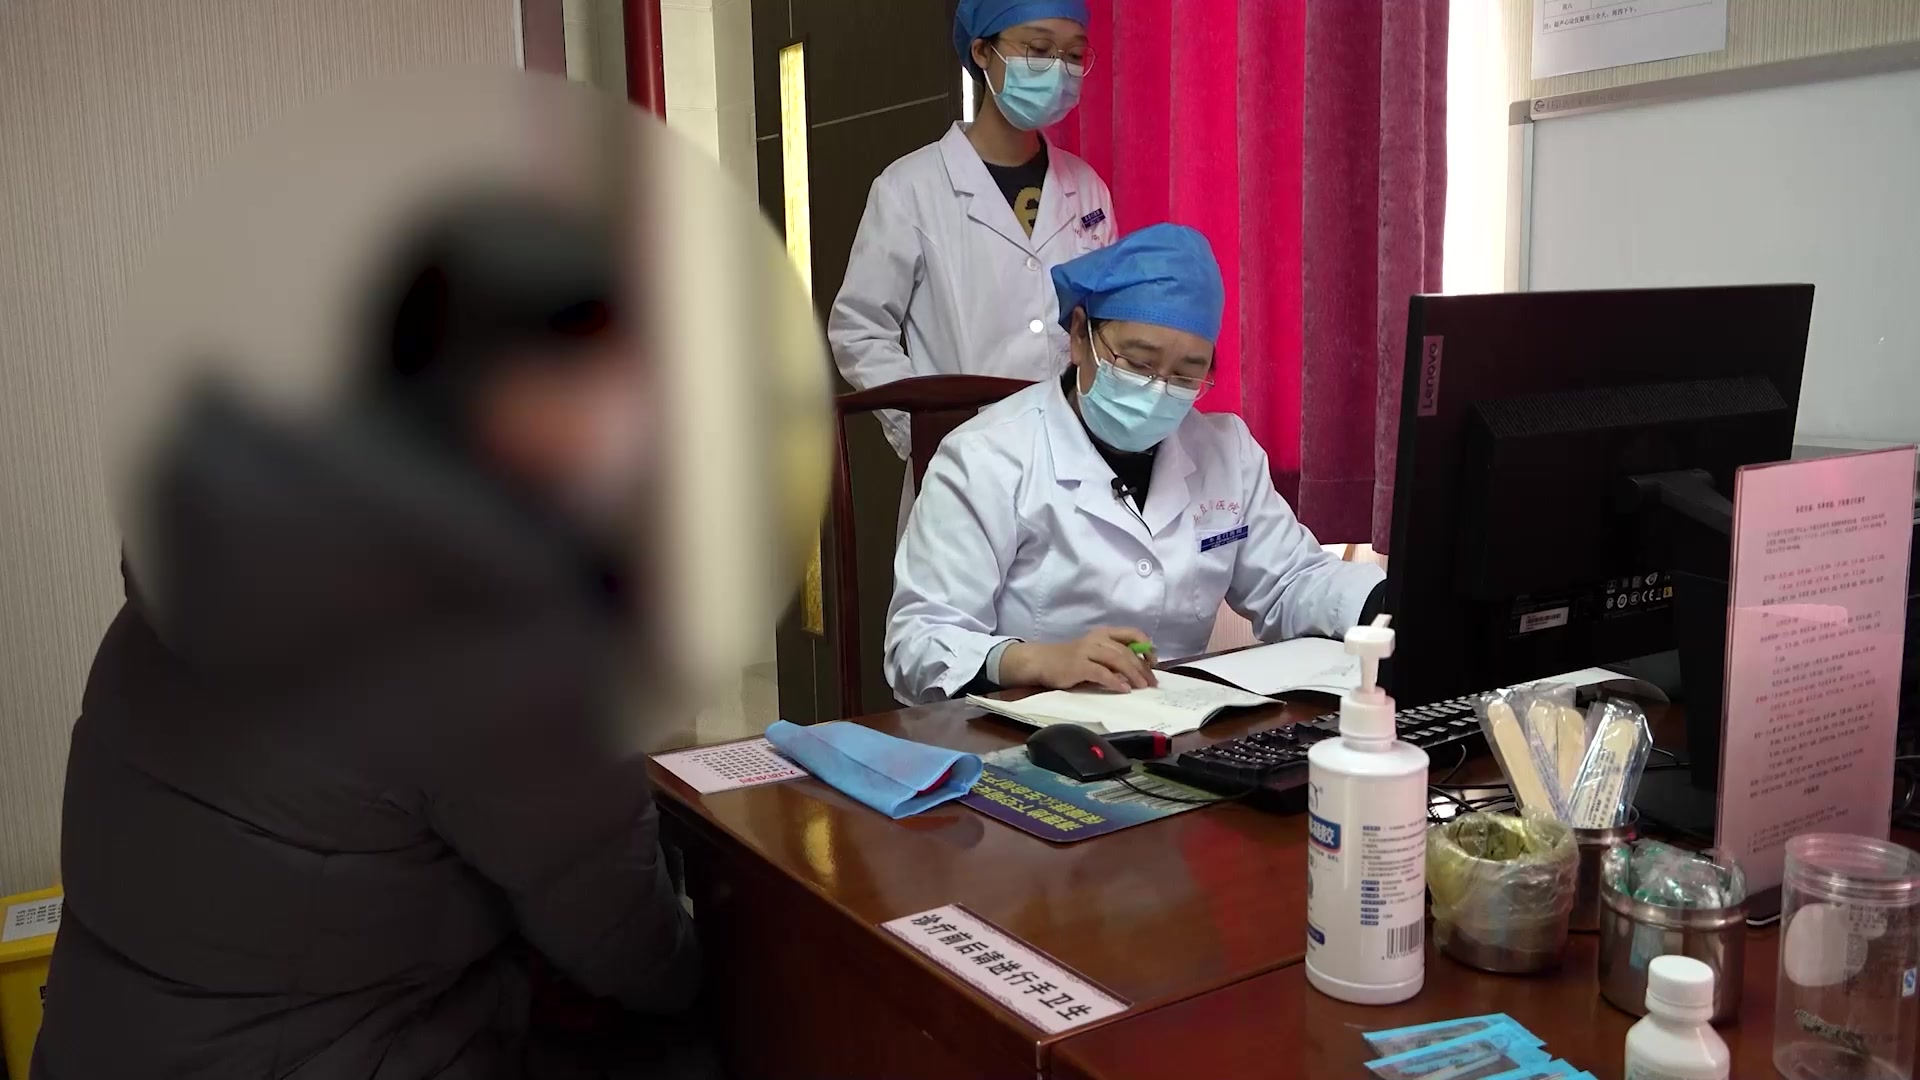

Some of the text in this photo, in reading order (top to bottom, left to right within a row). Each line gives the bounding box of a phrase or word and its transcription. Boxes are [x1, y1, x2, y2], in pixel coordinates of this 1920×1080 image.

[1422, 343, 1437, 409] Lenovo
[911, 914, 1092, 1021] 诊疗前后请进行手卫生
